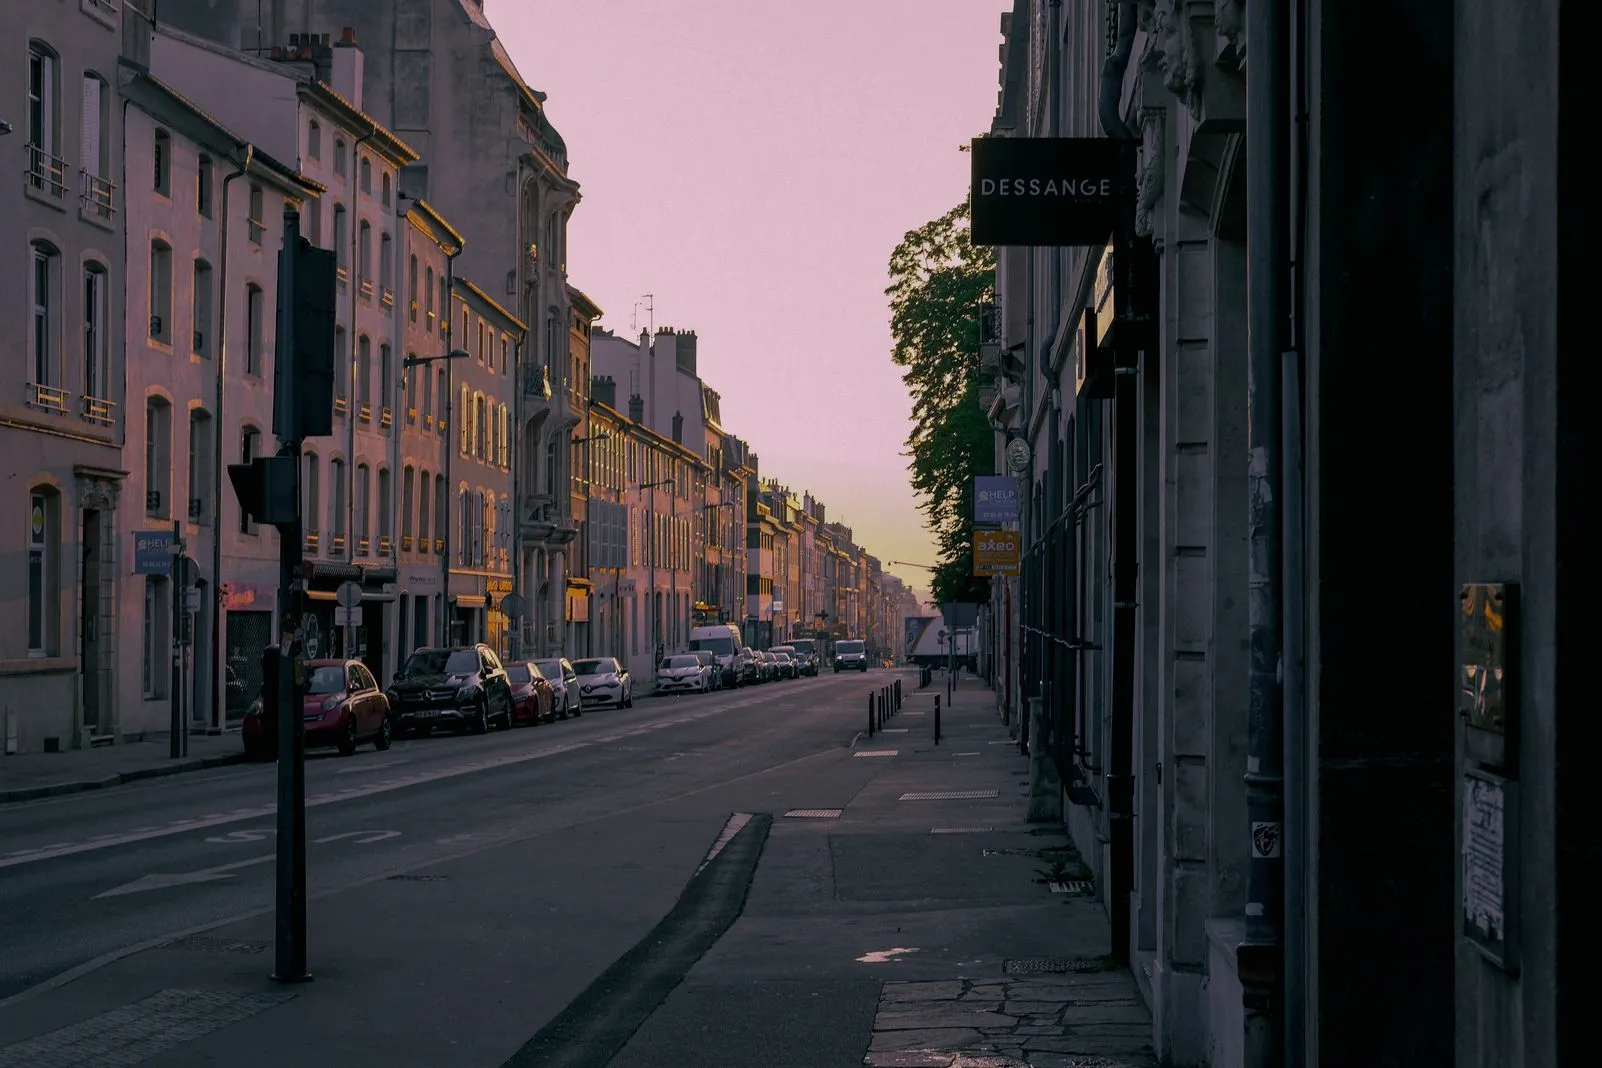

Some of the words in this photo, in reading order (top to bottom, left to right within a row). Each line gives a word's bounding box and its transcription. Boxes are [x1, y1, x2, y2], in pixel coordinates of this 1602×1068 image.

[980, 178, 1111, 197] DESSANGE
[989, 490, 1015, 499] HELP
[978, 540, 1015, 551] axeo
